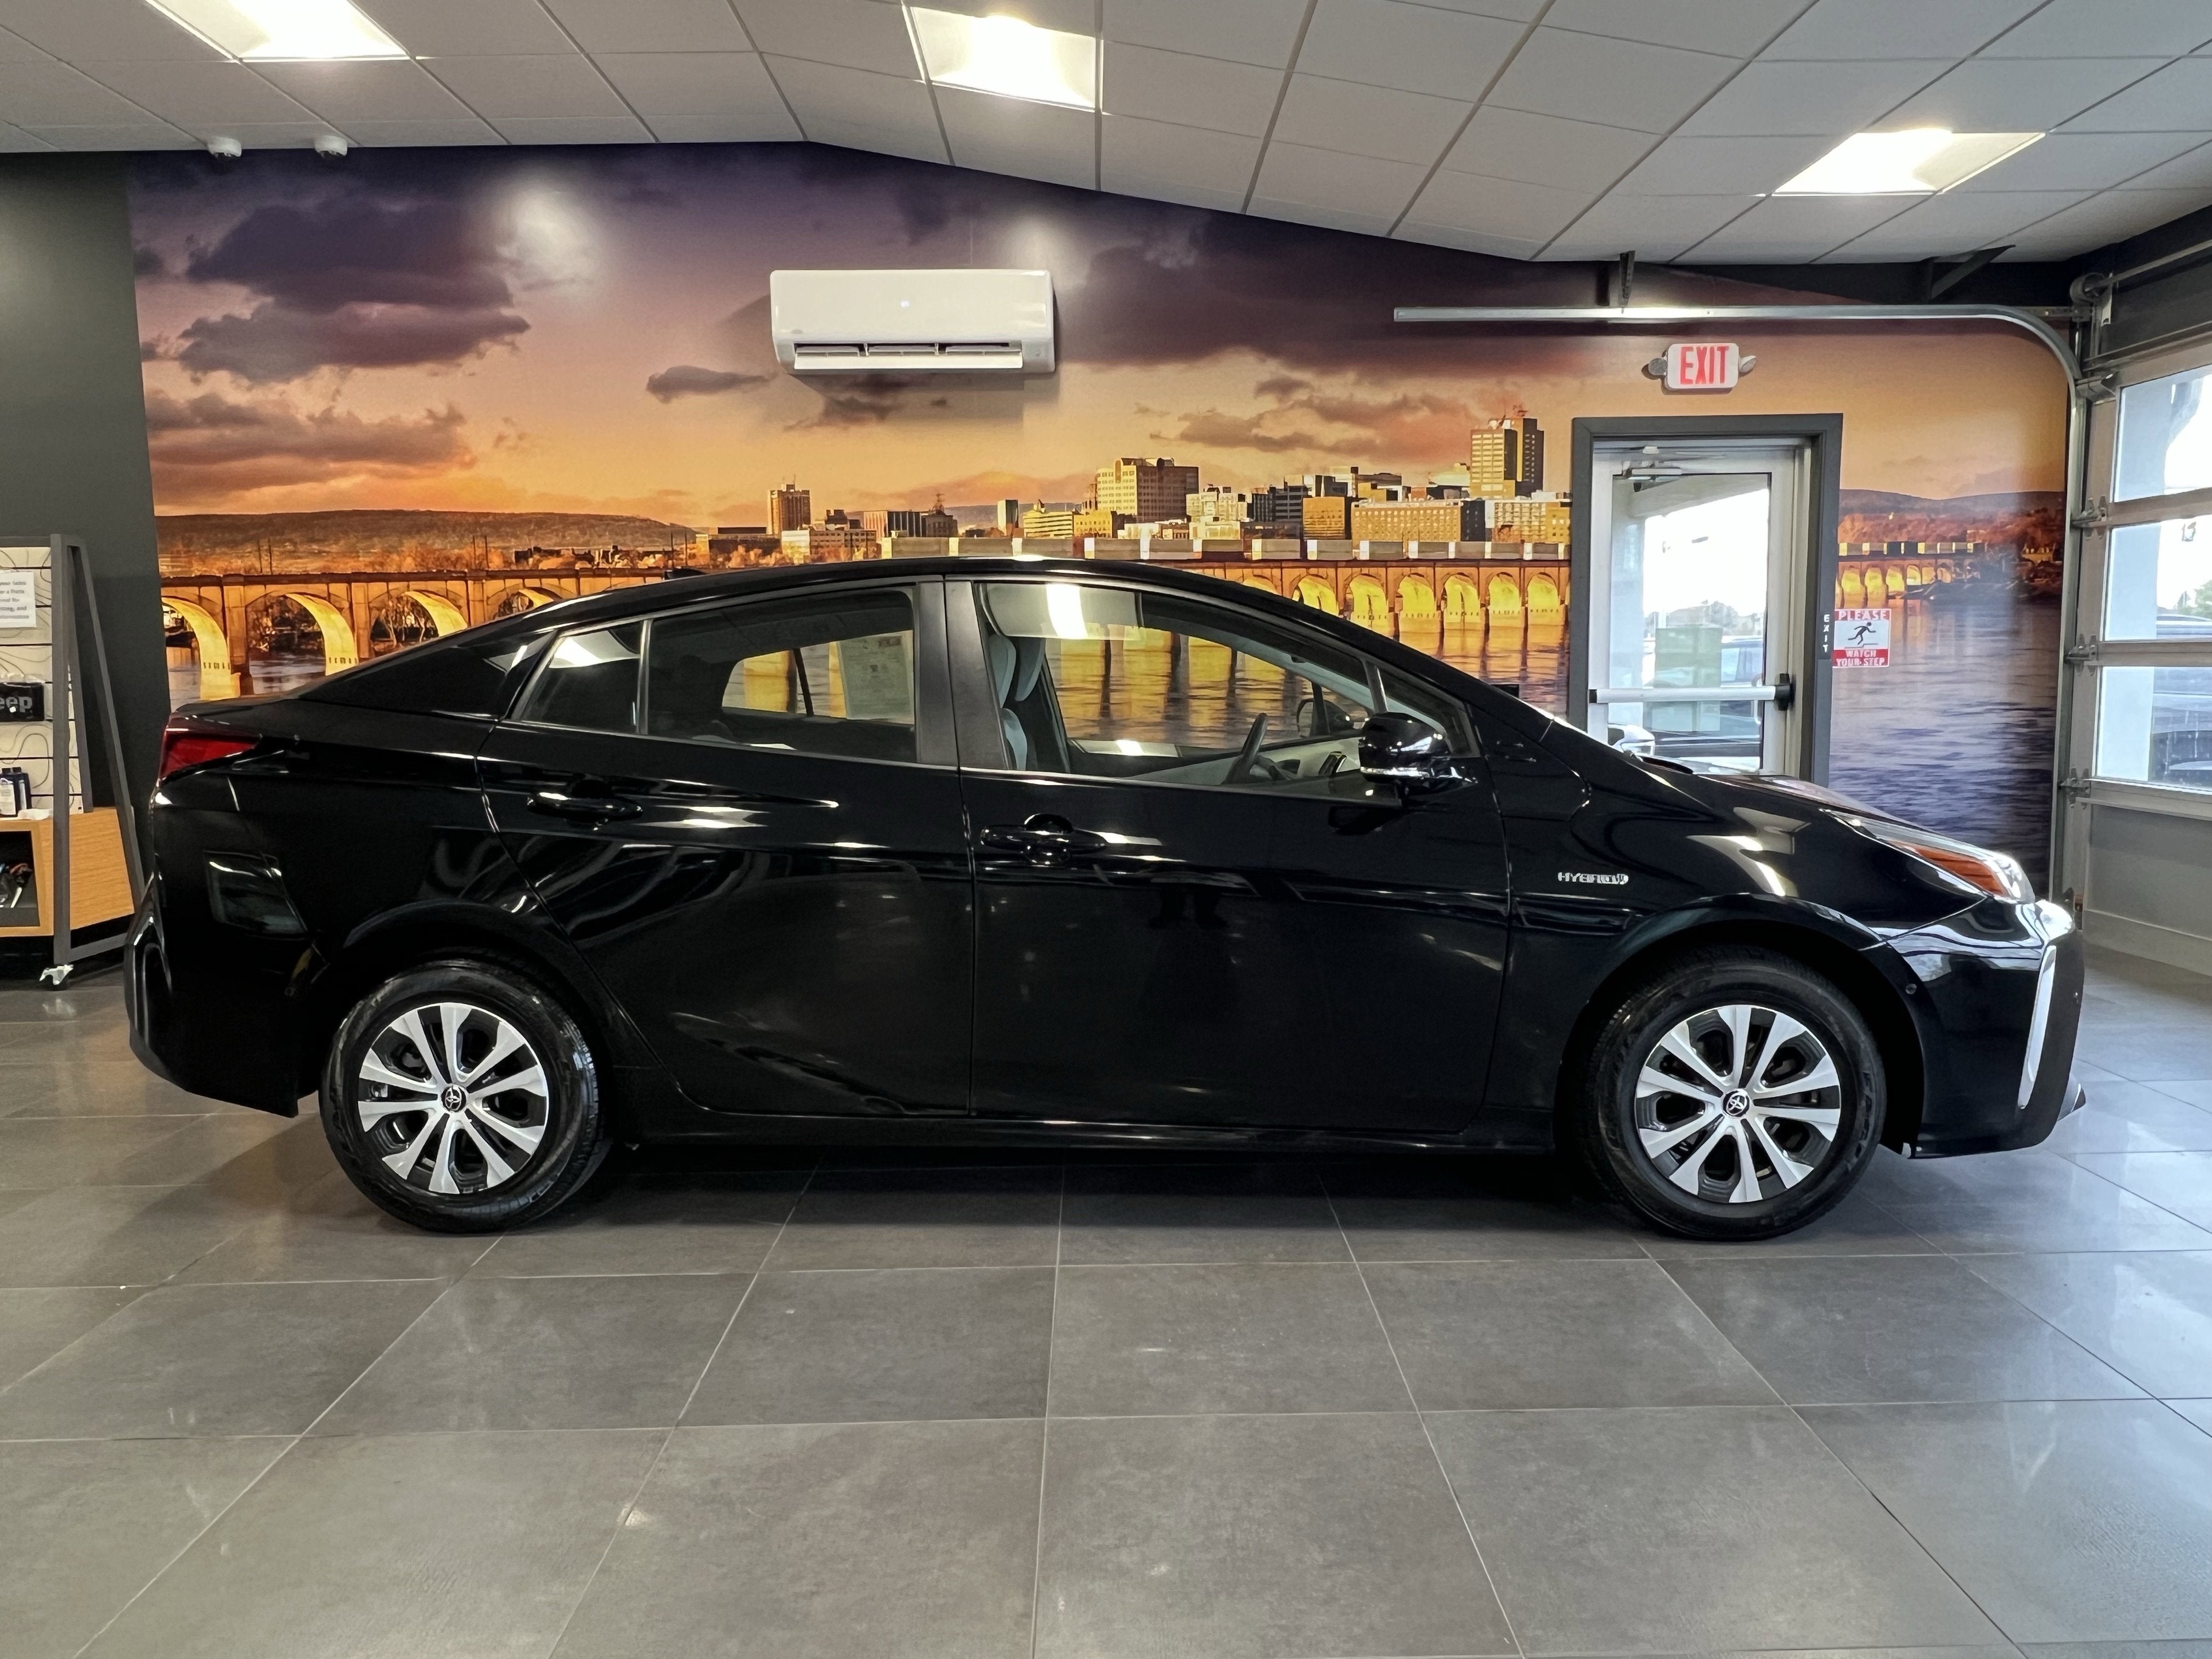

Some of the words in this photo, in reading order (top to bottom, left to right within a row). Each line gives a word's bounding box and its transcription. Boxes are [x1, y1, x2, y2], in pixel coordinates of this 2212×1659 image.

[1680, 346, 1730, 385] EXIT
[1838, 610, 1888, 621] PLEASE
[1845, 650, 1877, 658] WATCH
[1836, 658, 1862, 667] YOUR
[1863, 657, 1886, 667] STEP
[1558, 872, 1629, 885] HYBRID
